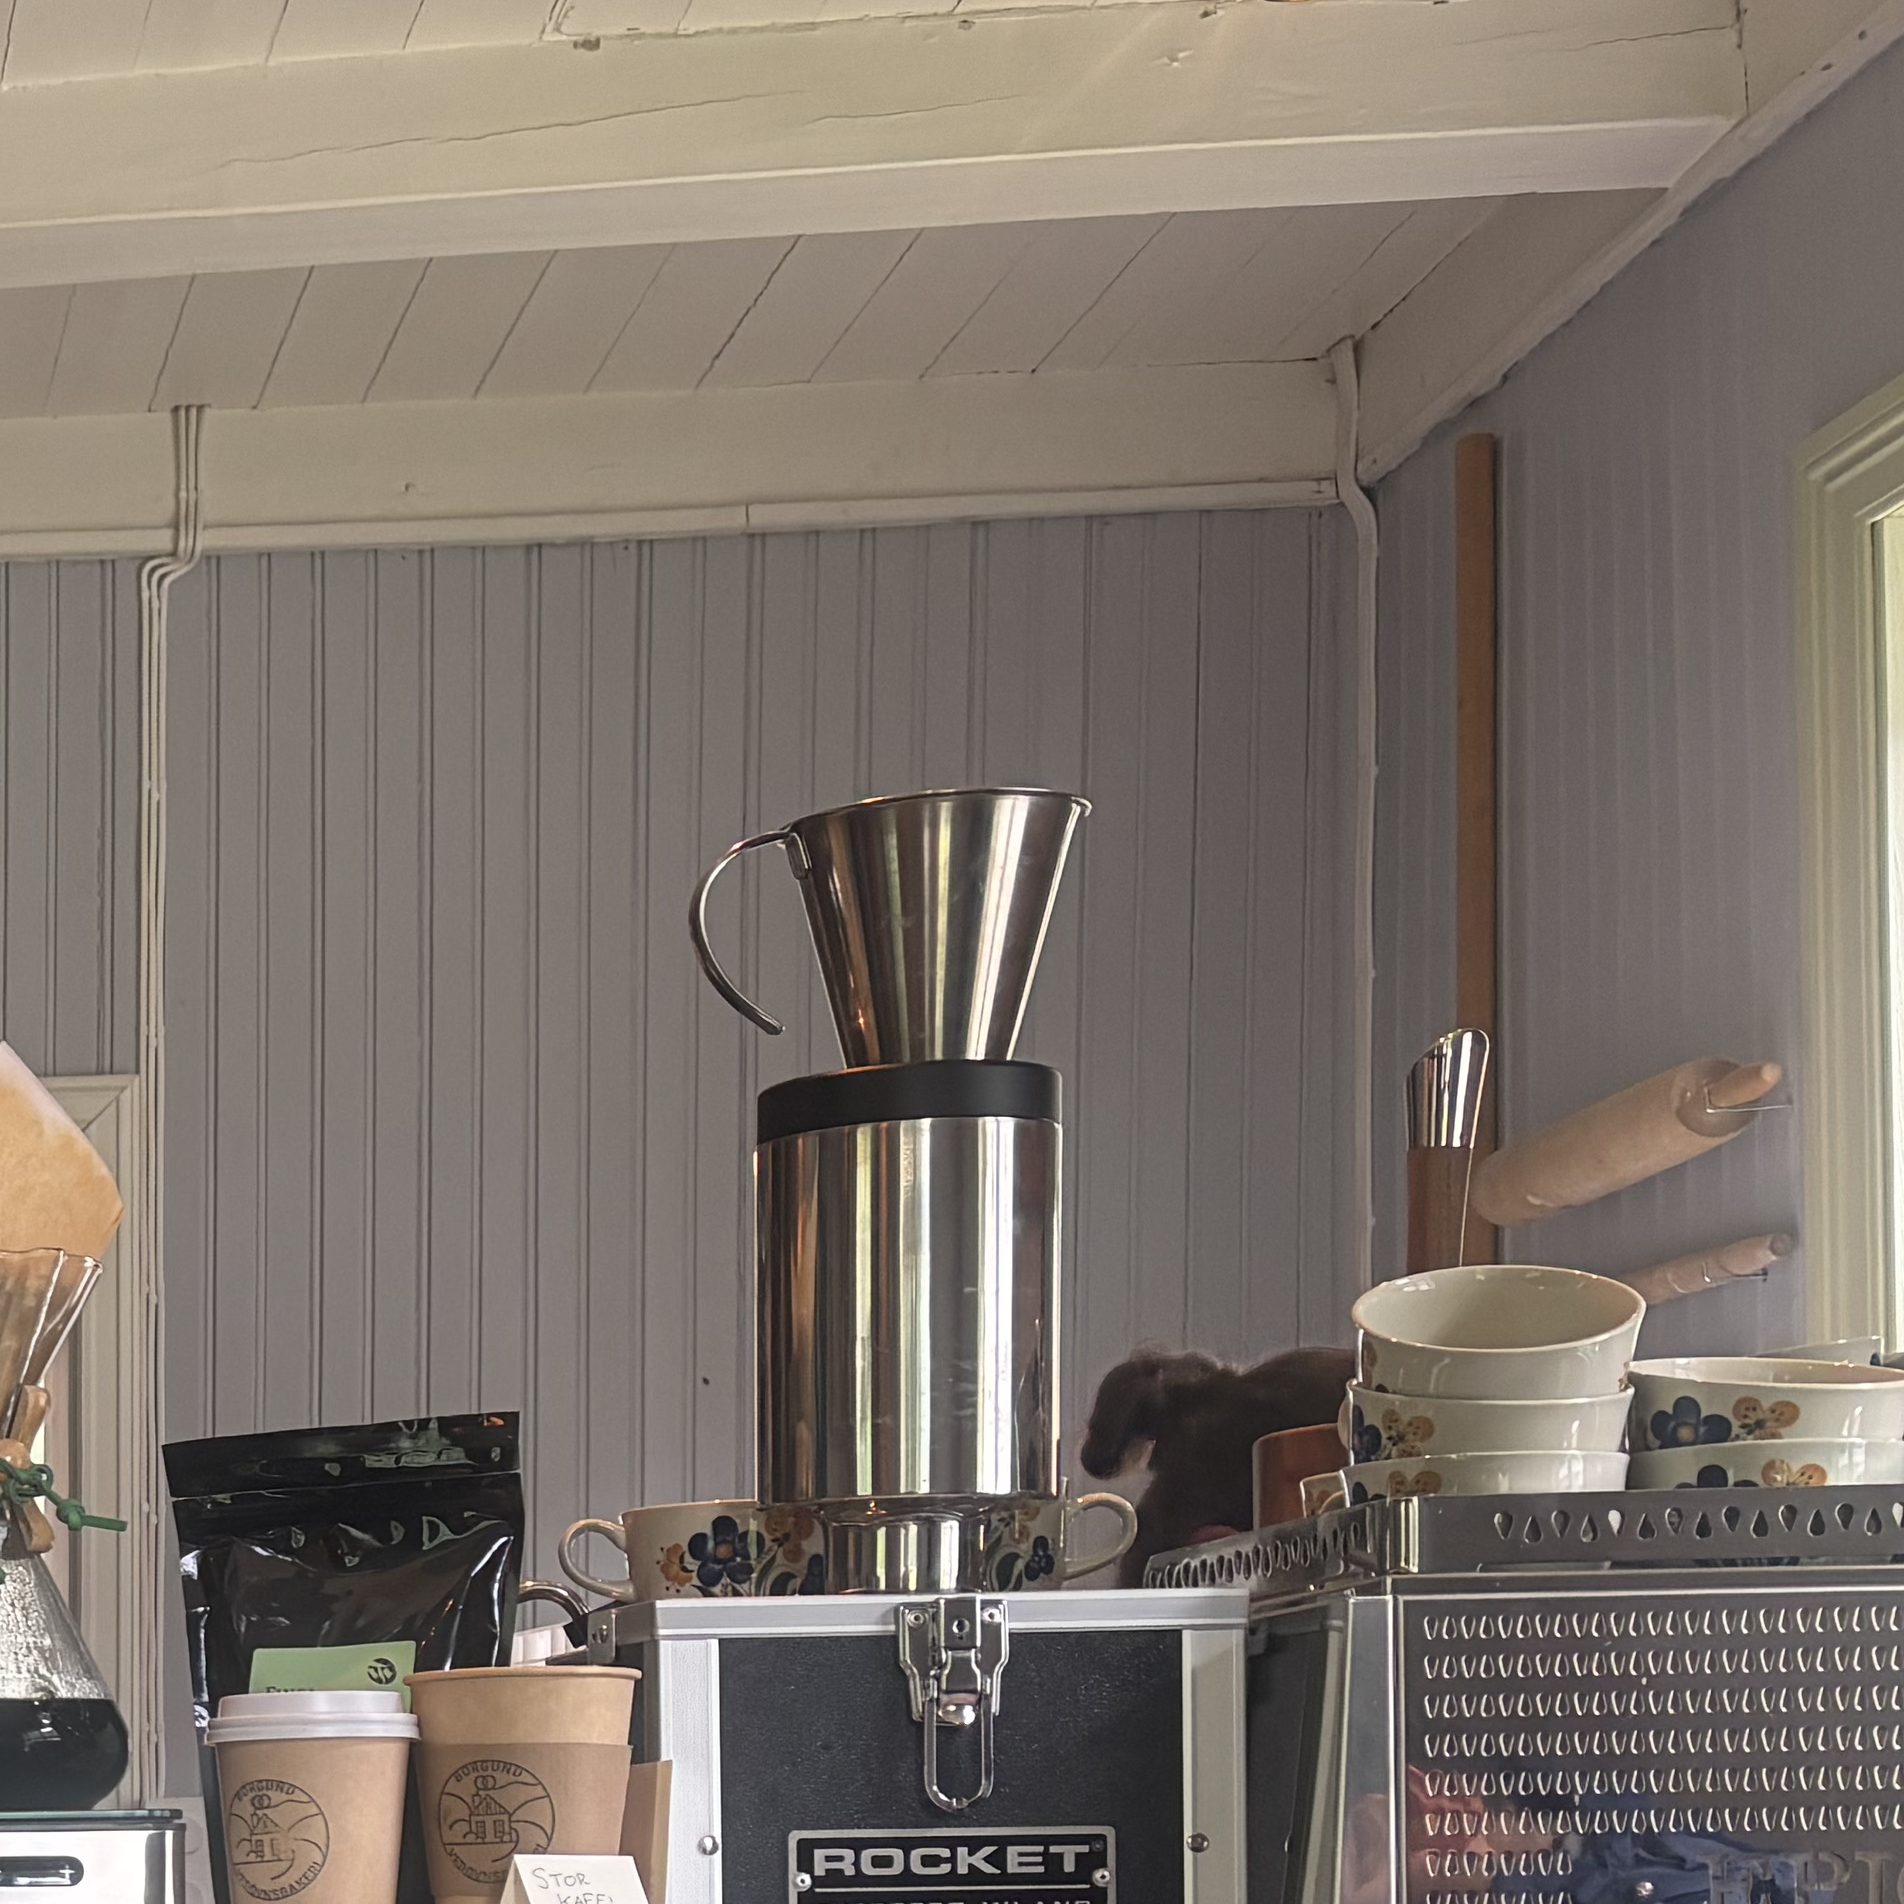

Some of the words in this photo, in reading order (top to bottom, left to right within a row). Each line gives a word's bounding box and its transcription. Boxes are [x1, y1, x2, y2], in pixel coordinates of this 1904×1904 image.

[454, 1760, 524, 1783] BORGUND
[813, 1844, 1091, 1877] ROCKET
[532, 1867, 592, 1890] STOR
